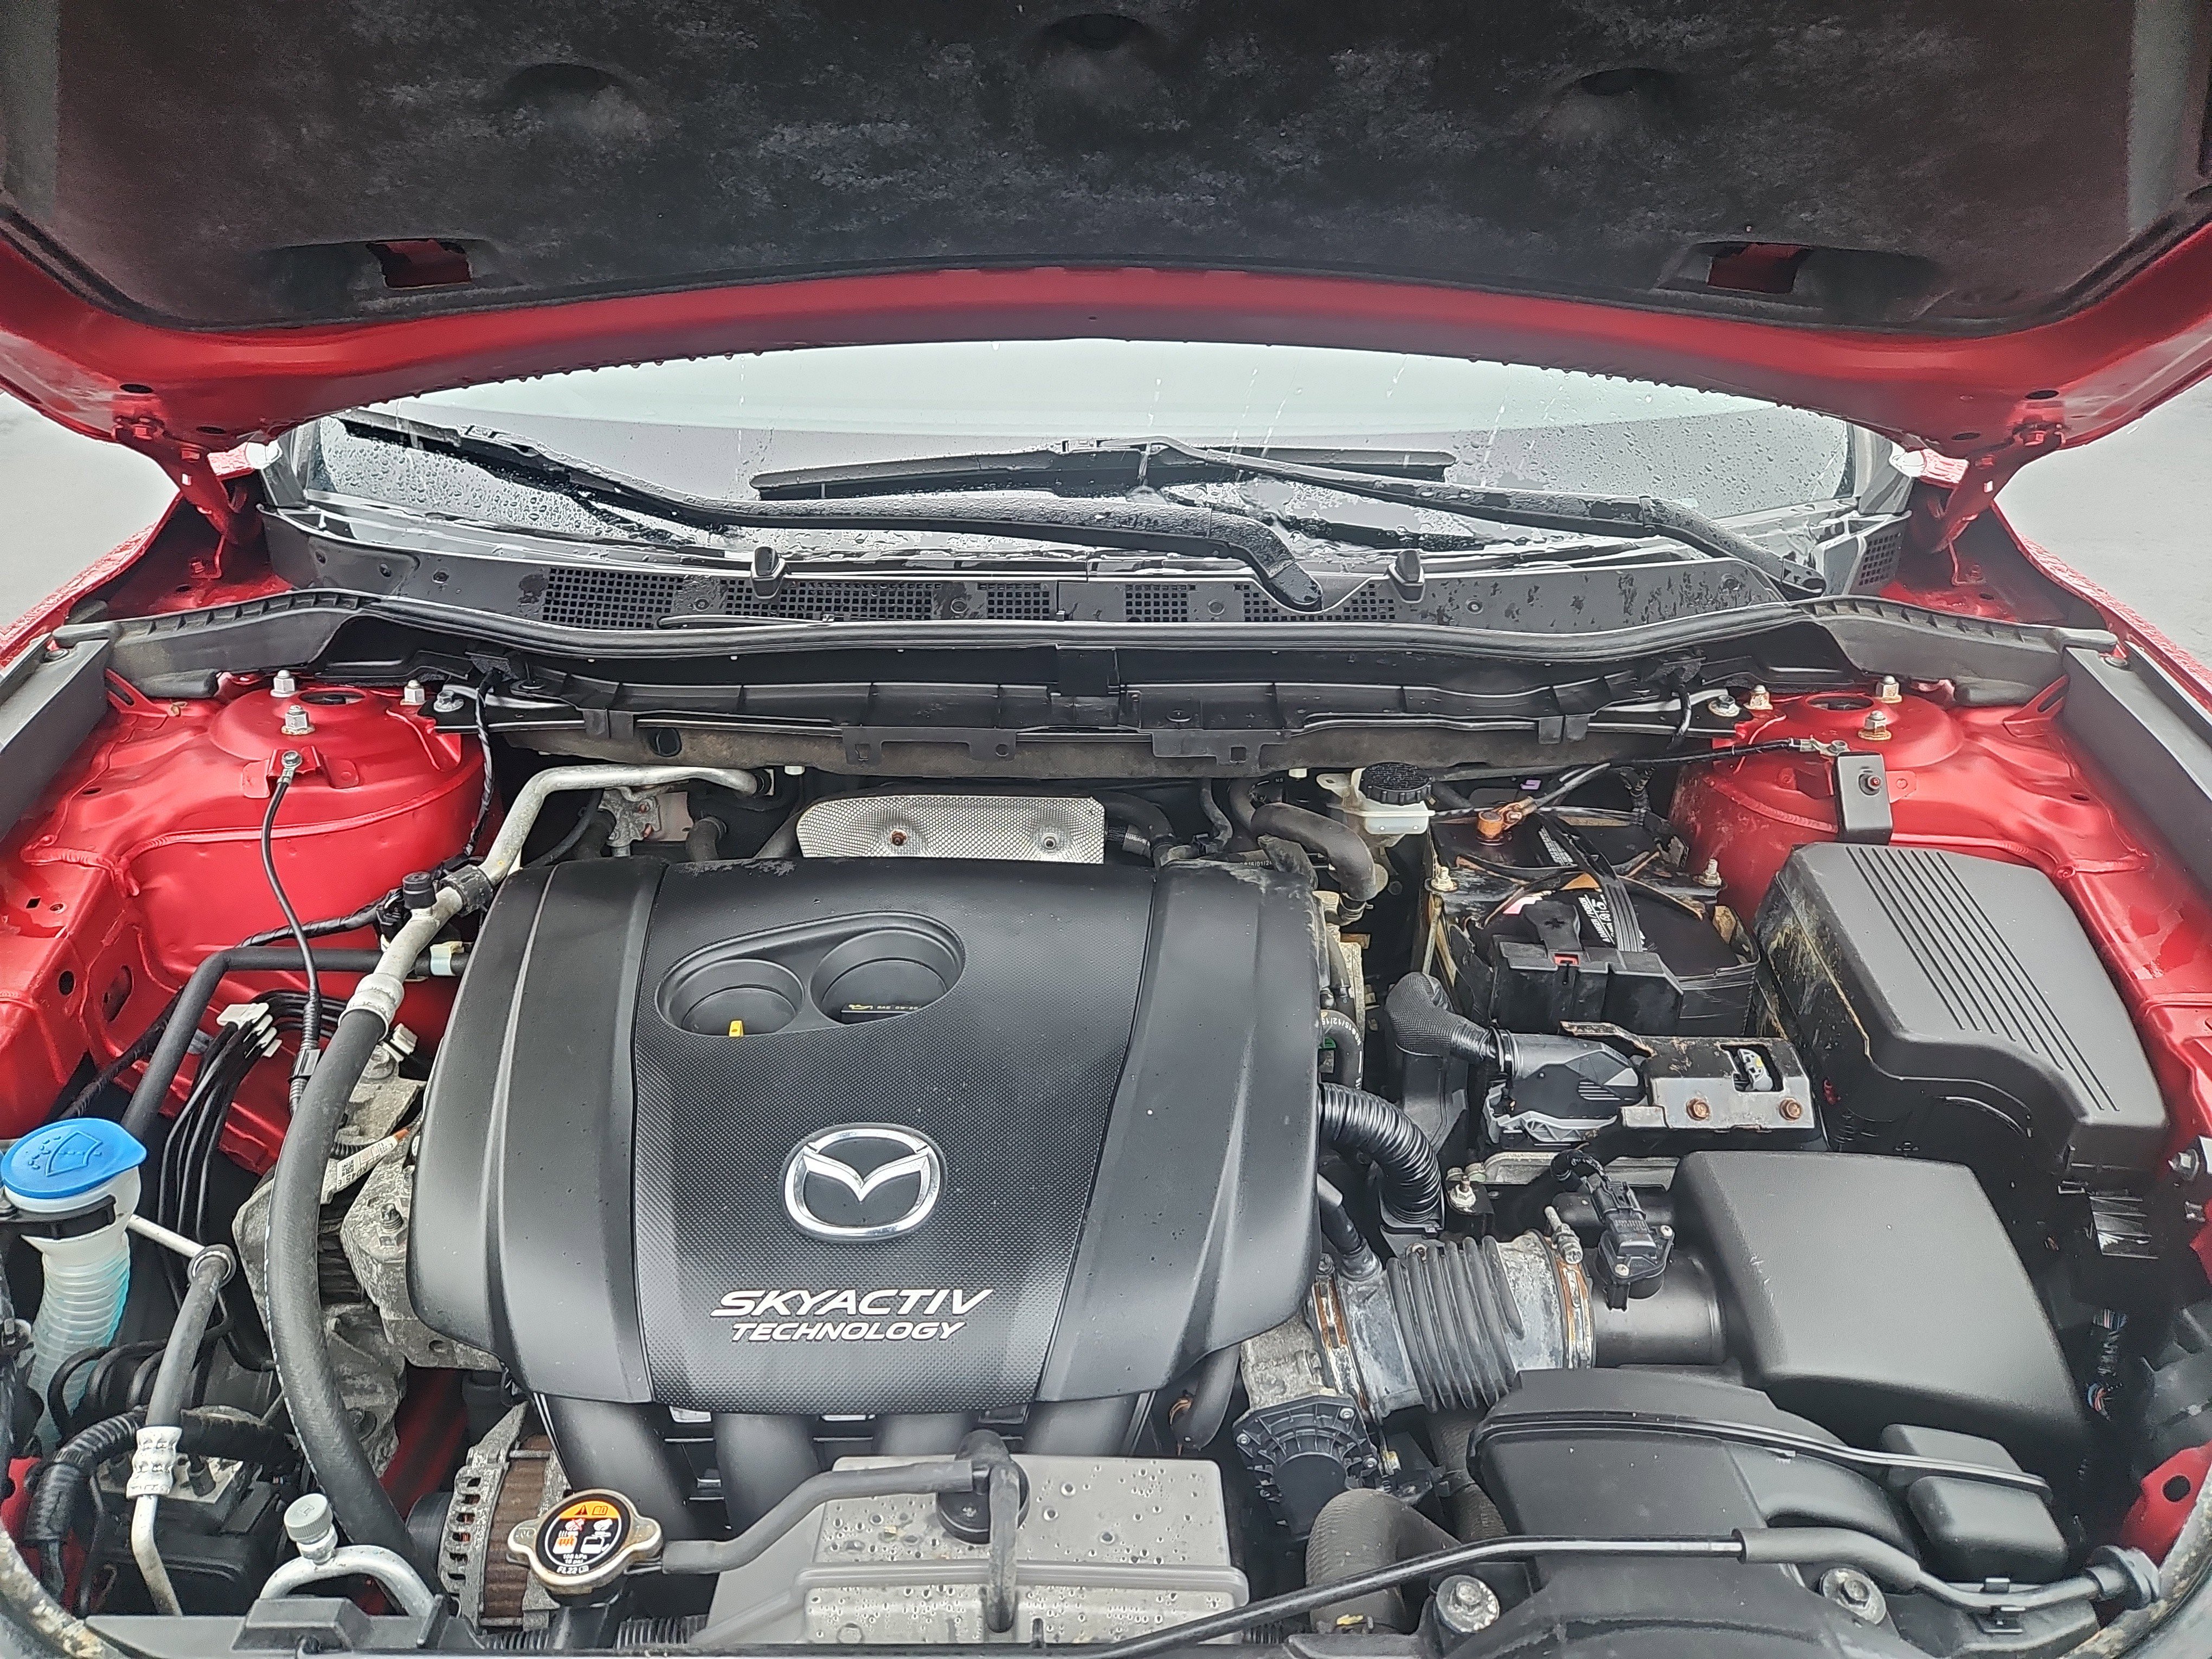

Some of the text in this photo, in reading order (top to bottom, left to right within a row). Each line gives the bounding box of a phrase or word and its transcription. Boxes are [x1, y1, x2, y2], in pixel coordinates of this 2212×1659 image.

[710, 1289, 993, 1316] SKYACTIV
[731, 1321, 967, 1342] TECHNOLOGY
[556, 1566, 578, 1574] FL22
